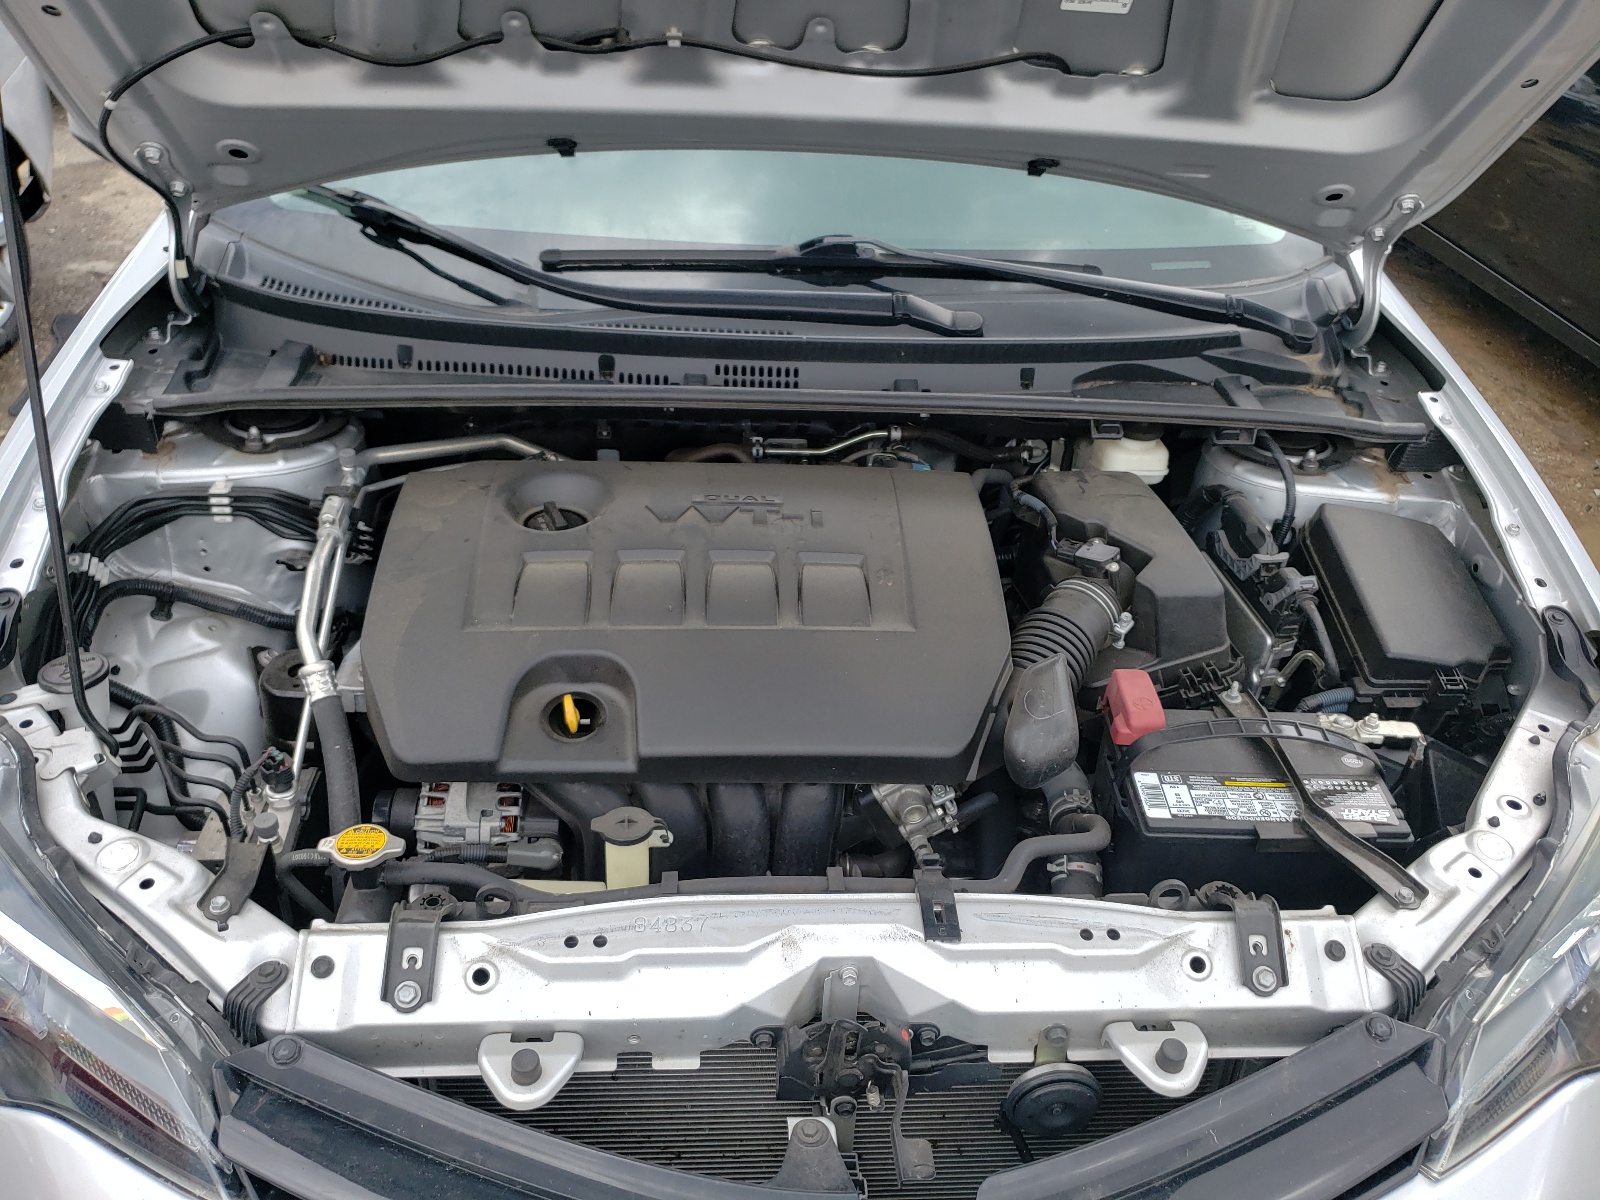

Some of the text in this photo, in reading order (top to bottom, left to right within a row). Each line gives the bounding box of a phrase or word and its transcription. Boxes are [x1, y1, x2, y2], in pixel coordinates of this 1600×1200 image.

[1342, 808, 1391, 817] START
[1343, 814, 1388, 822] SUPER
[634, 914, 709, 933] 84837
